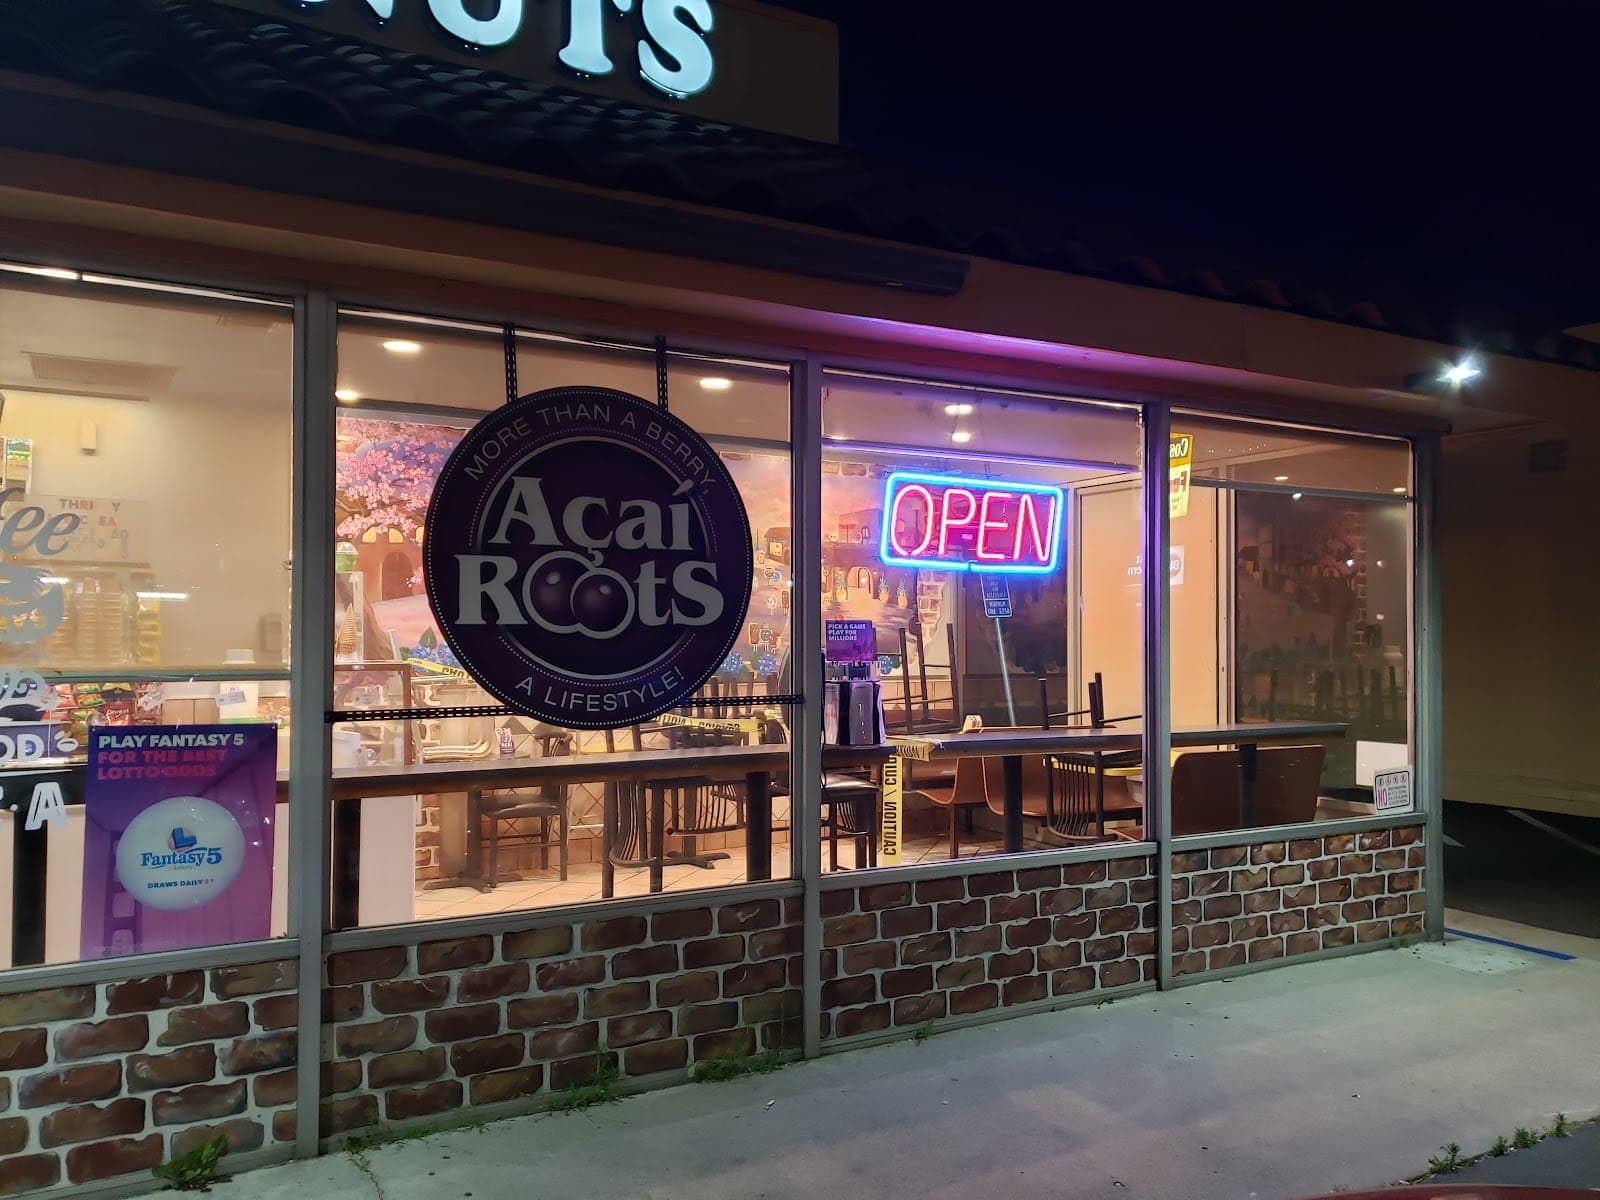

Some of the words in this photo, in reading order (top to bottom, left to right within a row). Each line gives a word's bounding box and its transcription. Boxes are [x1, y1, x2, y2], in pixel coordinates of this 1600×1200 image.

[464, 416, 532, 480] MORE
[536, 403, 610, 427] THAN
[620, 411, 636, 430] A
[487, 476, 694, 567] Açaí
[890, 485, 1055, 562] OPEN
[515, 676, 533, 696] A
[544, 666, 685, 711] LIFESTYLE!
[99, 735, 147, 748] PLAY
[150, 734, 231, 748] FANTASY
[233, 733, 244, 747] 5
[97, 750, 136, 764] FOR
[142, 750, 178, 763] THE
[183, 748, 227, 762] BEST
[97, 766, 161, 780] LOTTO
[163, 764, 217, 778] ODDS
[1377, 788, 1388, 807] NO
[141, 850, 206, 868] Fantasy
[206, 847, 223, 865] 5
[147, 881, 178, 889] DRAWS
